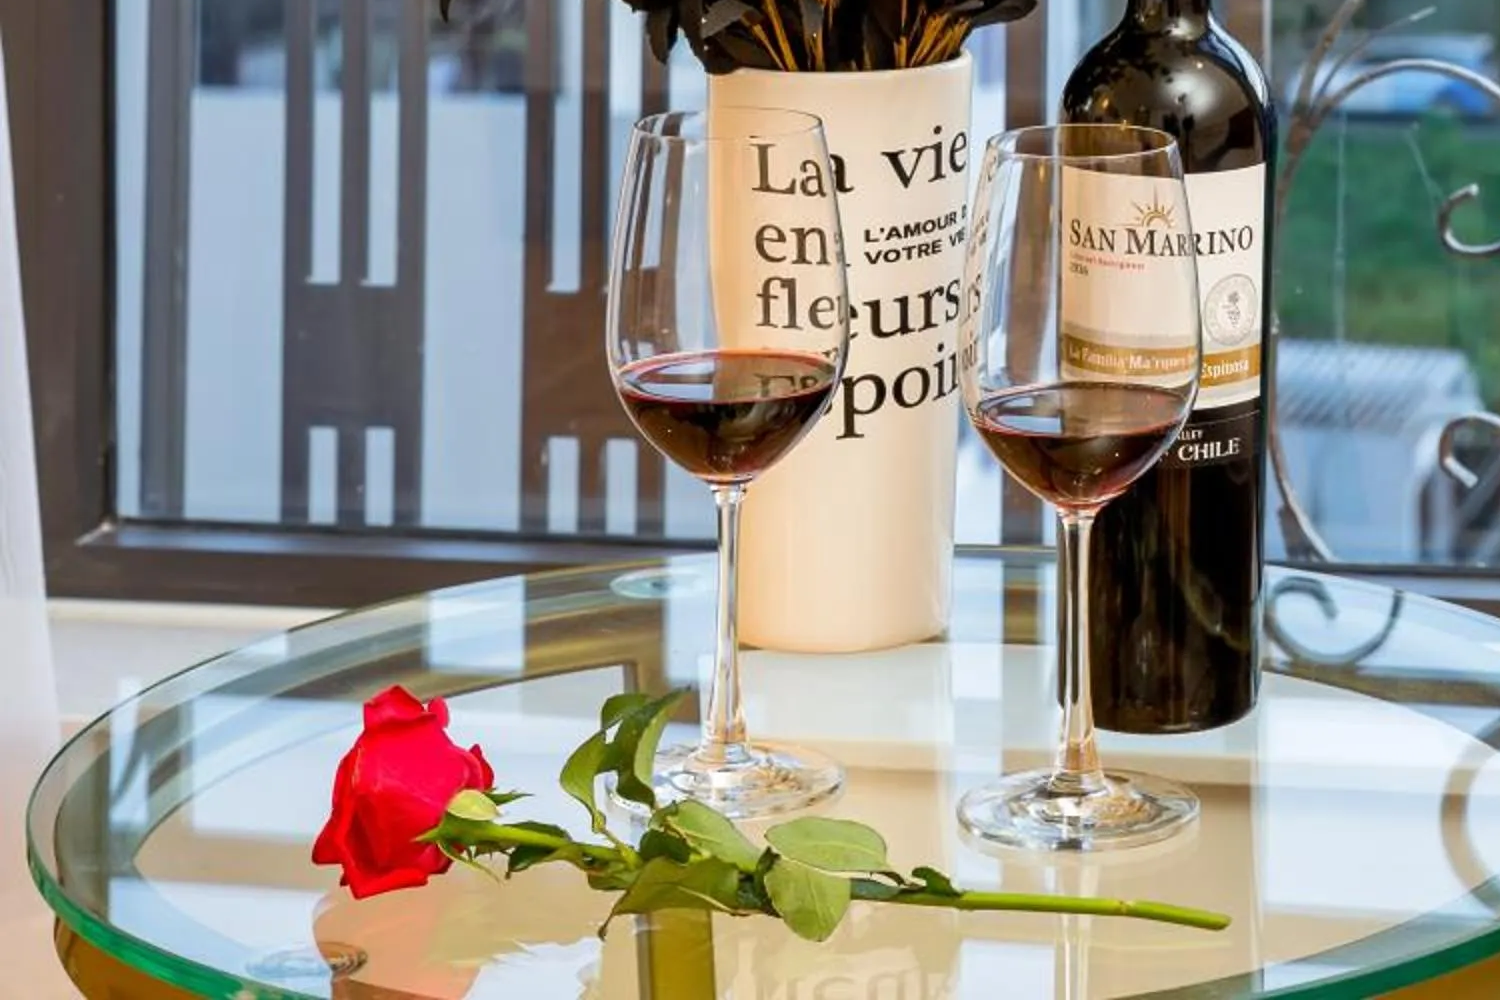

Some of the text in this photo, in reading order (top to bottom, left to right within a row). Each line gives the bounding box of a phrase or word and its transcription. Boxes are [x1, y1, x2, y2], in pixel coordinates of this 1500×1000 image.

[881, 125, 968, 189] vie
[864, 210, 957, 243] L'AMOUR
[1069, 219, 1115, 251] SAN
[755, 222, 832, 266] en
[864, 239, 943, 265] VOTRE
[1177, 437, 1241, 461] CHILE
